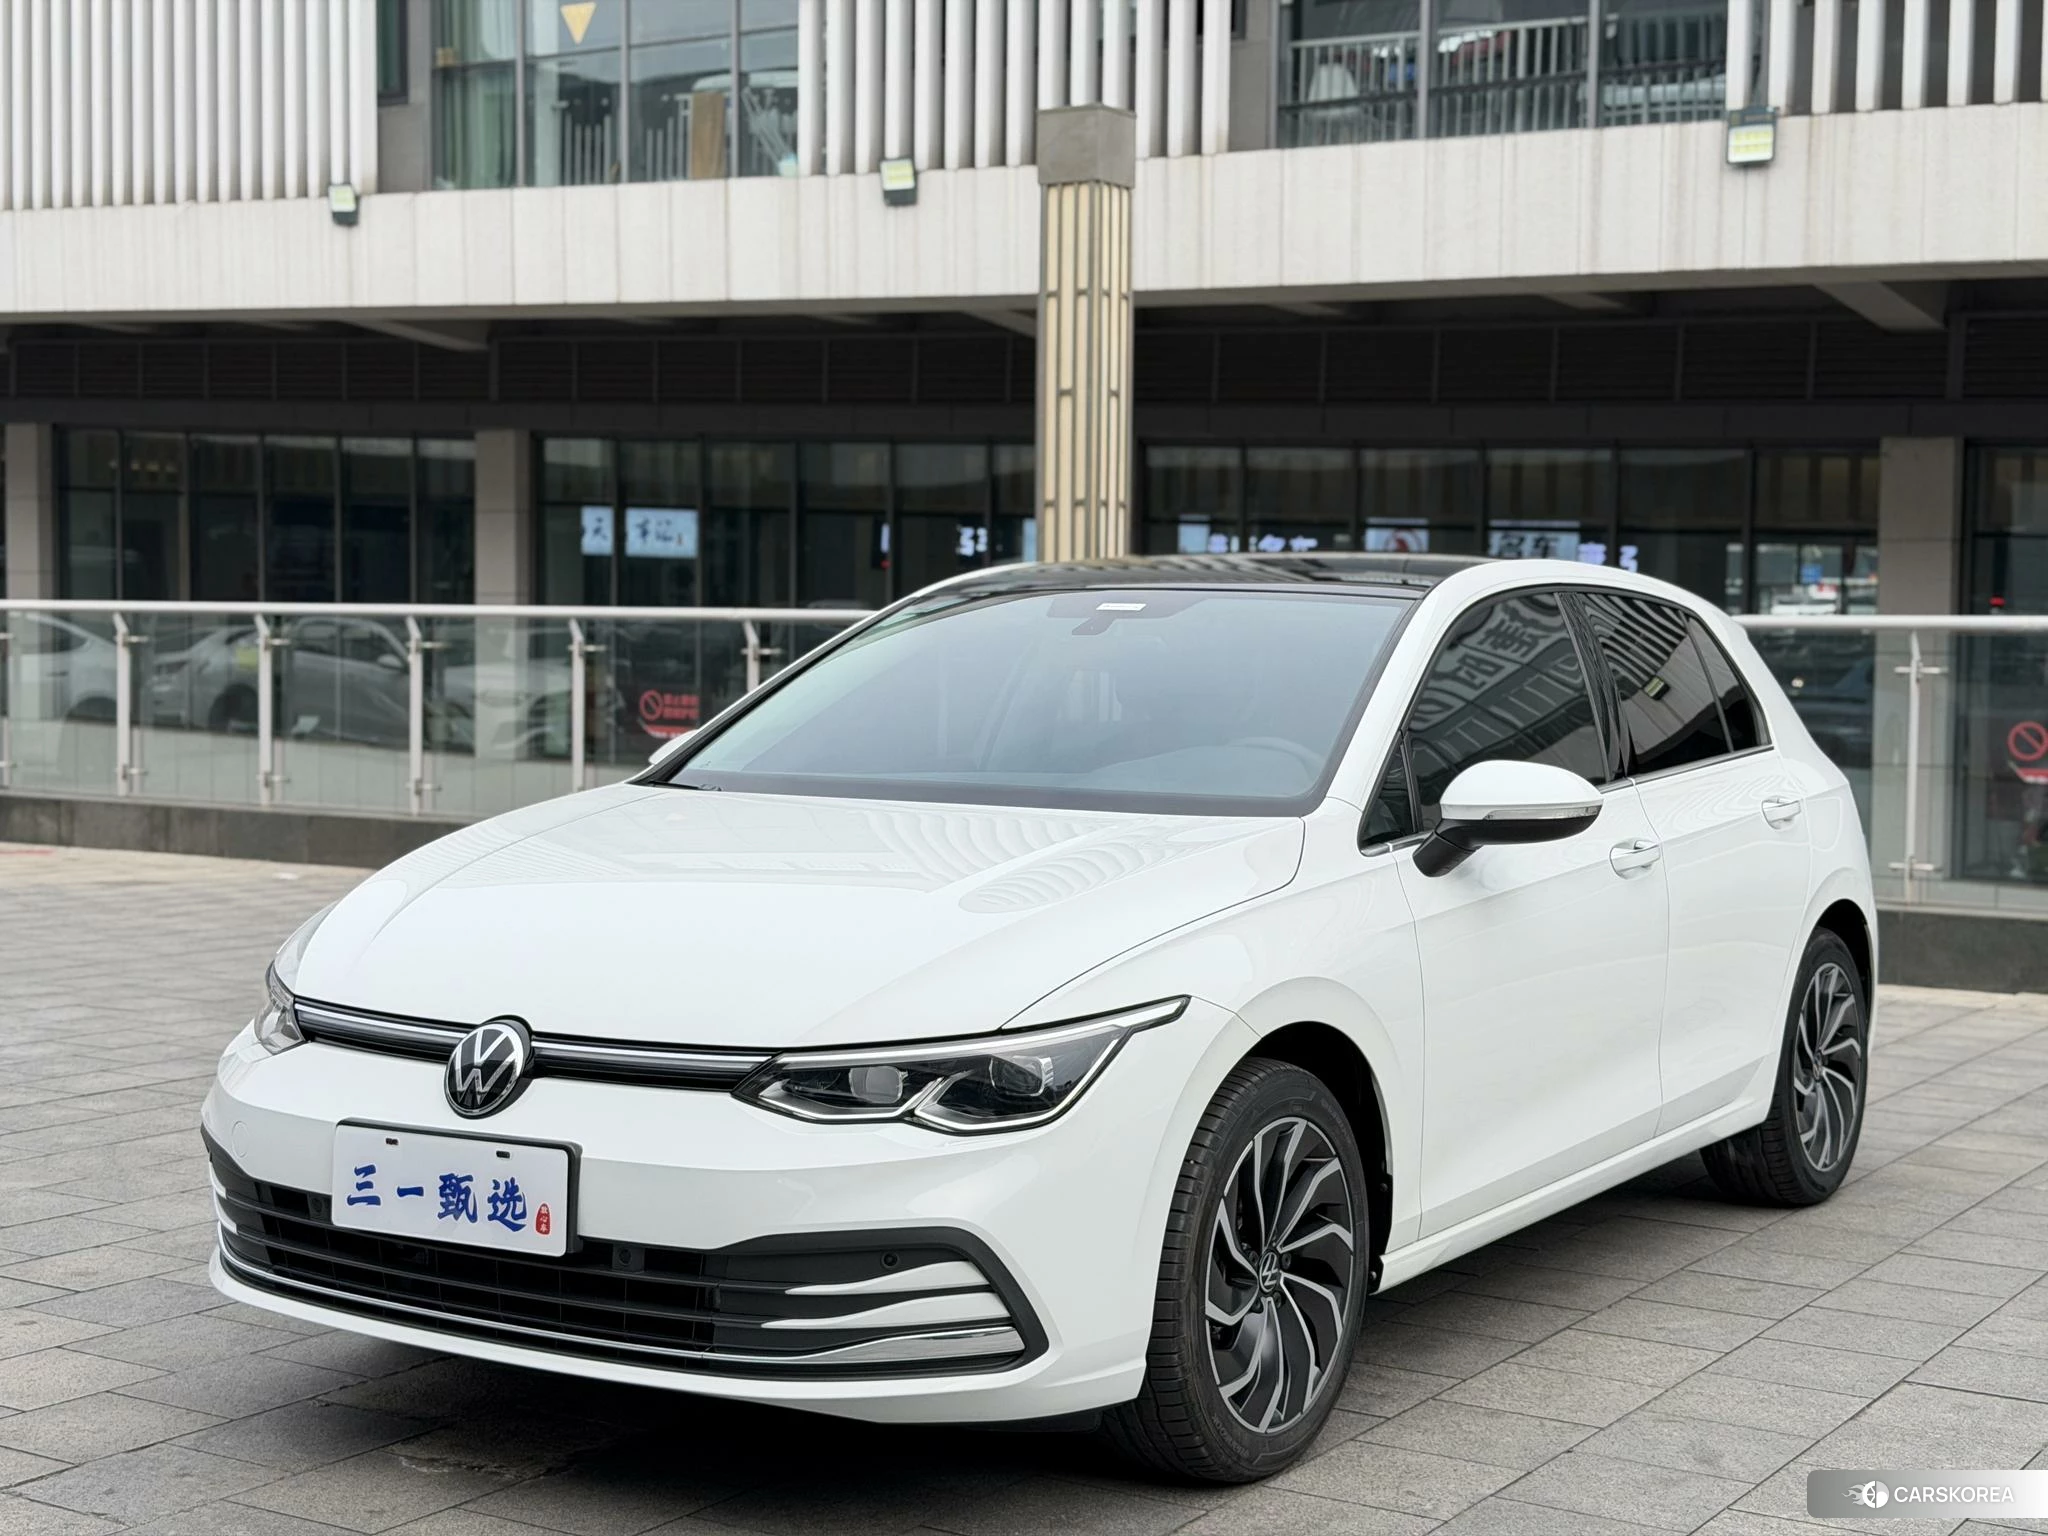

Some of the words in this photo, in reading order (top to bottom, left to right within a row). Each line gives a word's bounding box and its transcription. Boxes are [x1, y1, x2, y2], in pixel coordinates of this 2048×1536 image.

[449, 1026, 520, 1107] VW
[347, 1164, 527, 1232] 三一甄选
